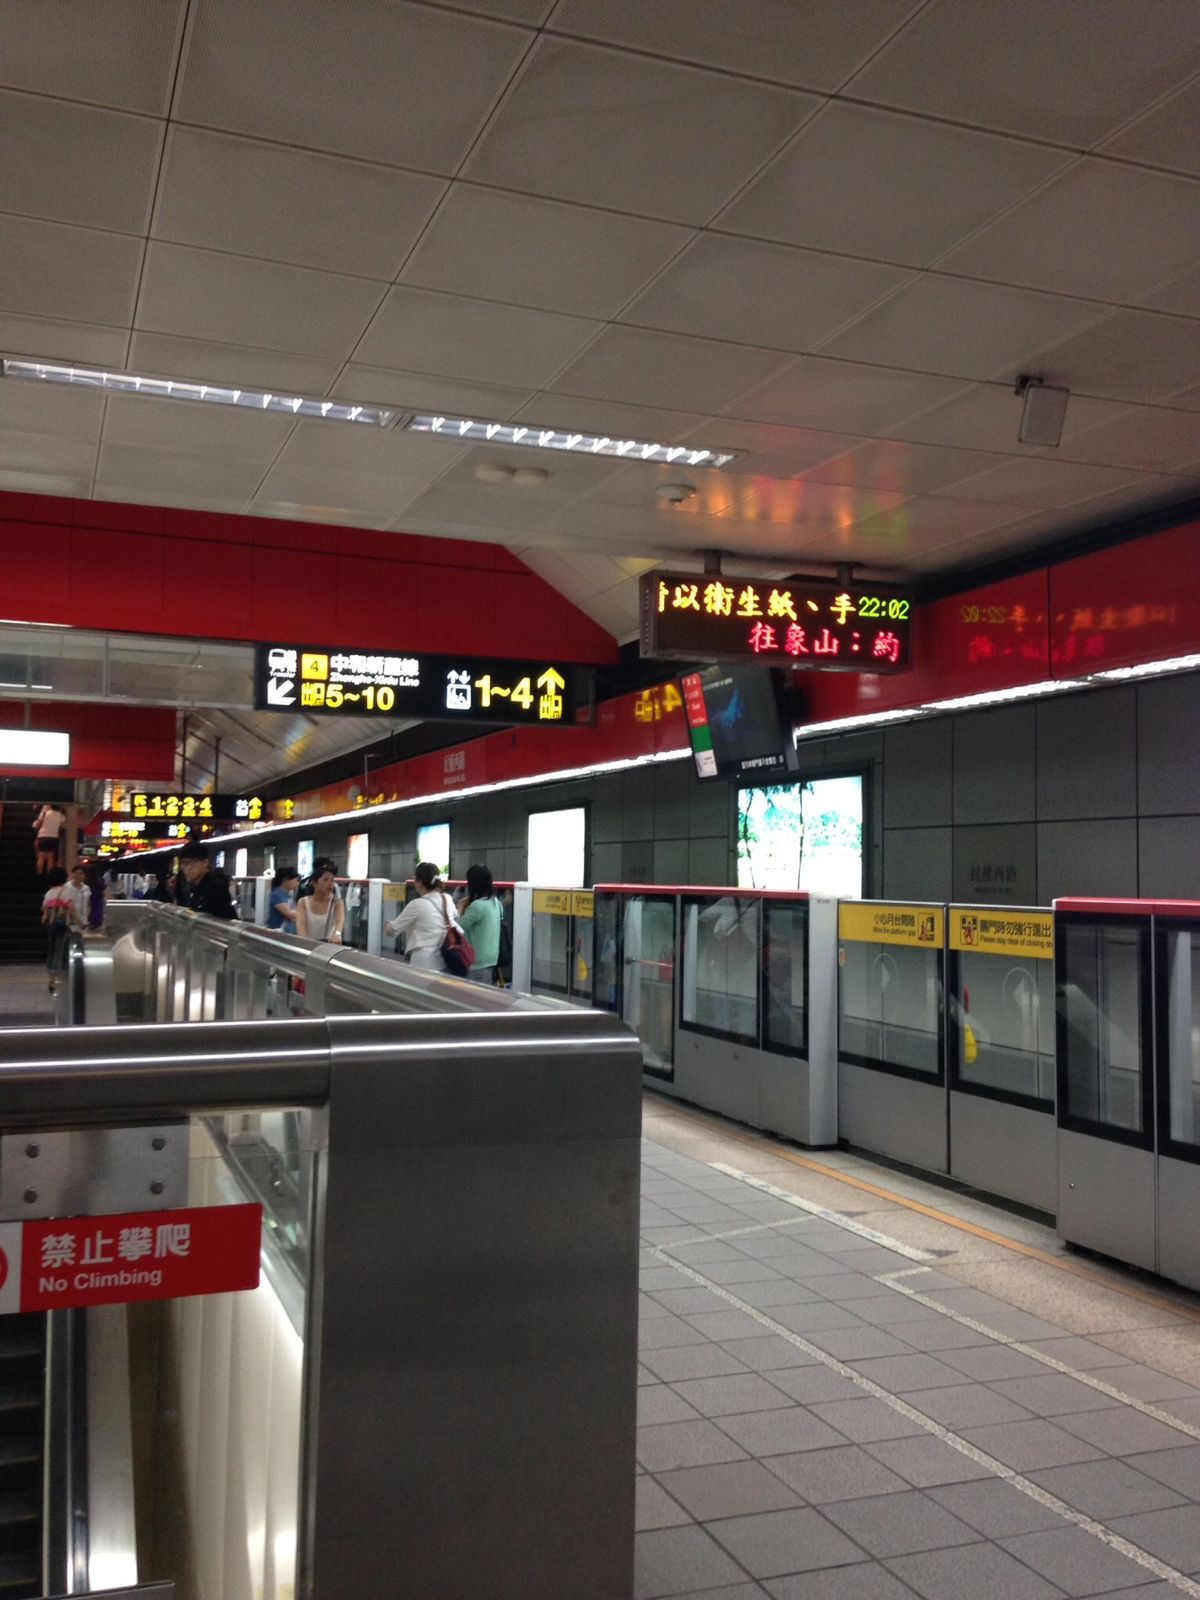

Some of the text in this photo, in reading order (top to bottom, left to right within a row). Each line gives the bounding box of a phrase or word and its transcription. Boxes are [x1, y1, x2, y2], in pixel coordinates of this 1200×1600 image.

[858, 597, 909, 620] 22:02
[326, 683, 394, 711] 5~10
[475, 675, 534, 709] 1~4
[980, 935, 995, 943] Please
[996, 937, 1006, 946] stay
[41, 1223, 191, 1268] 禁止攀爬
[39, 1268, 162, 1293] No Climbing
